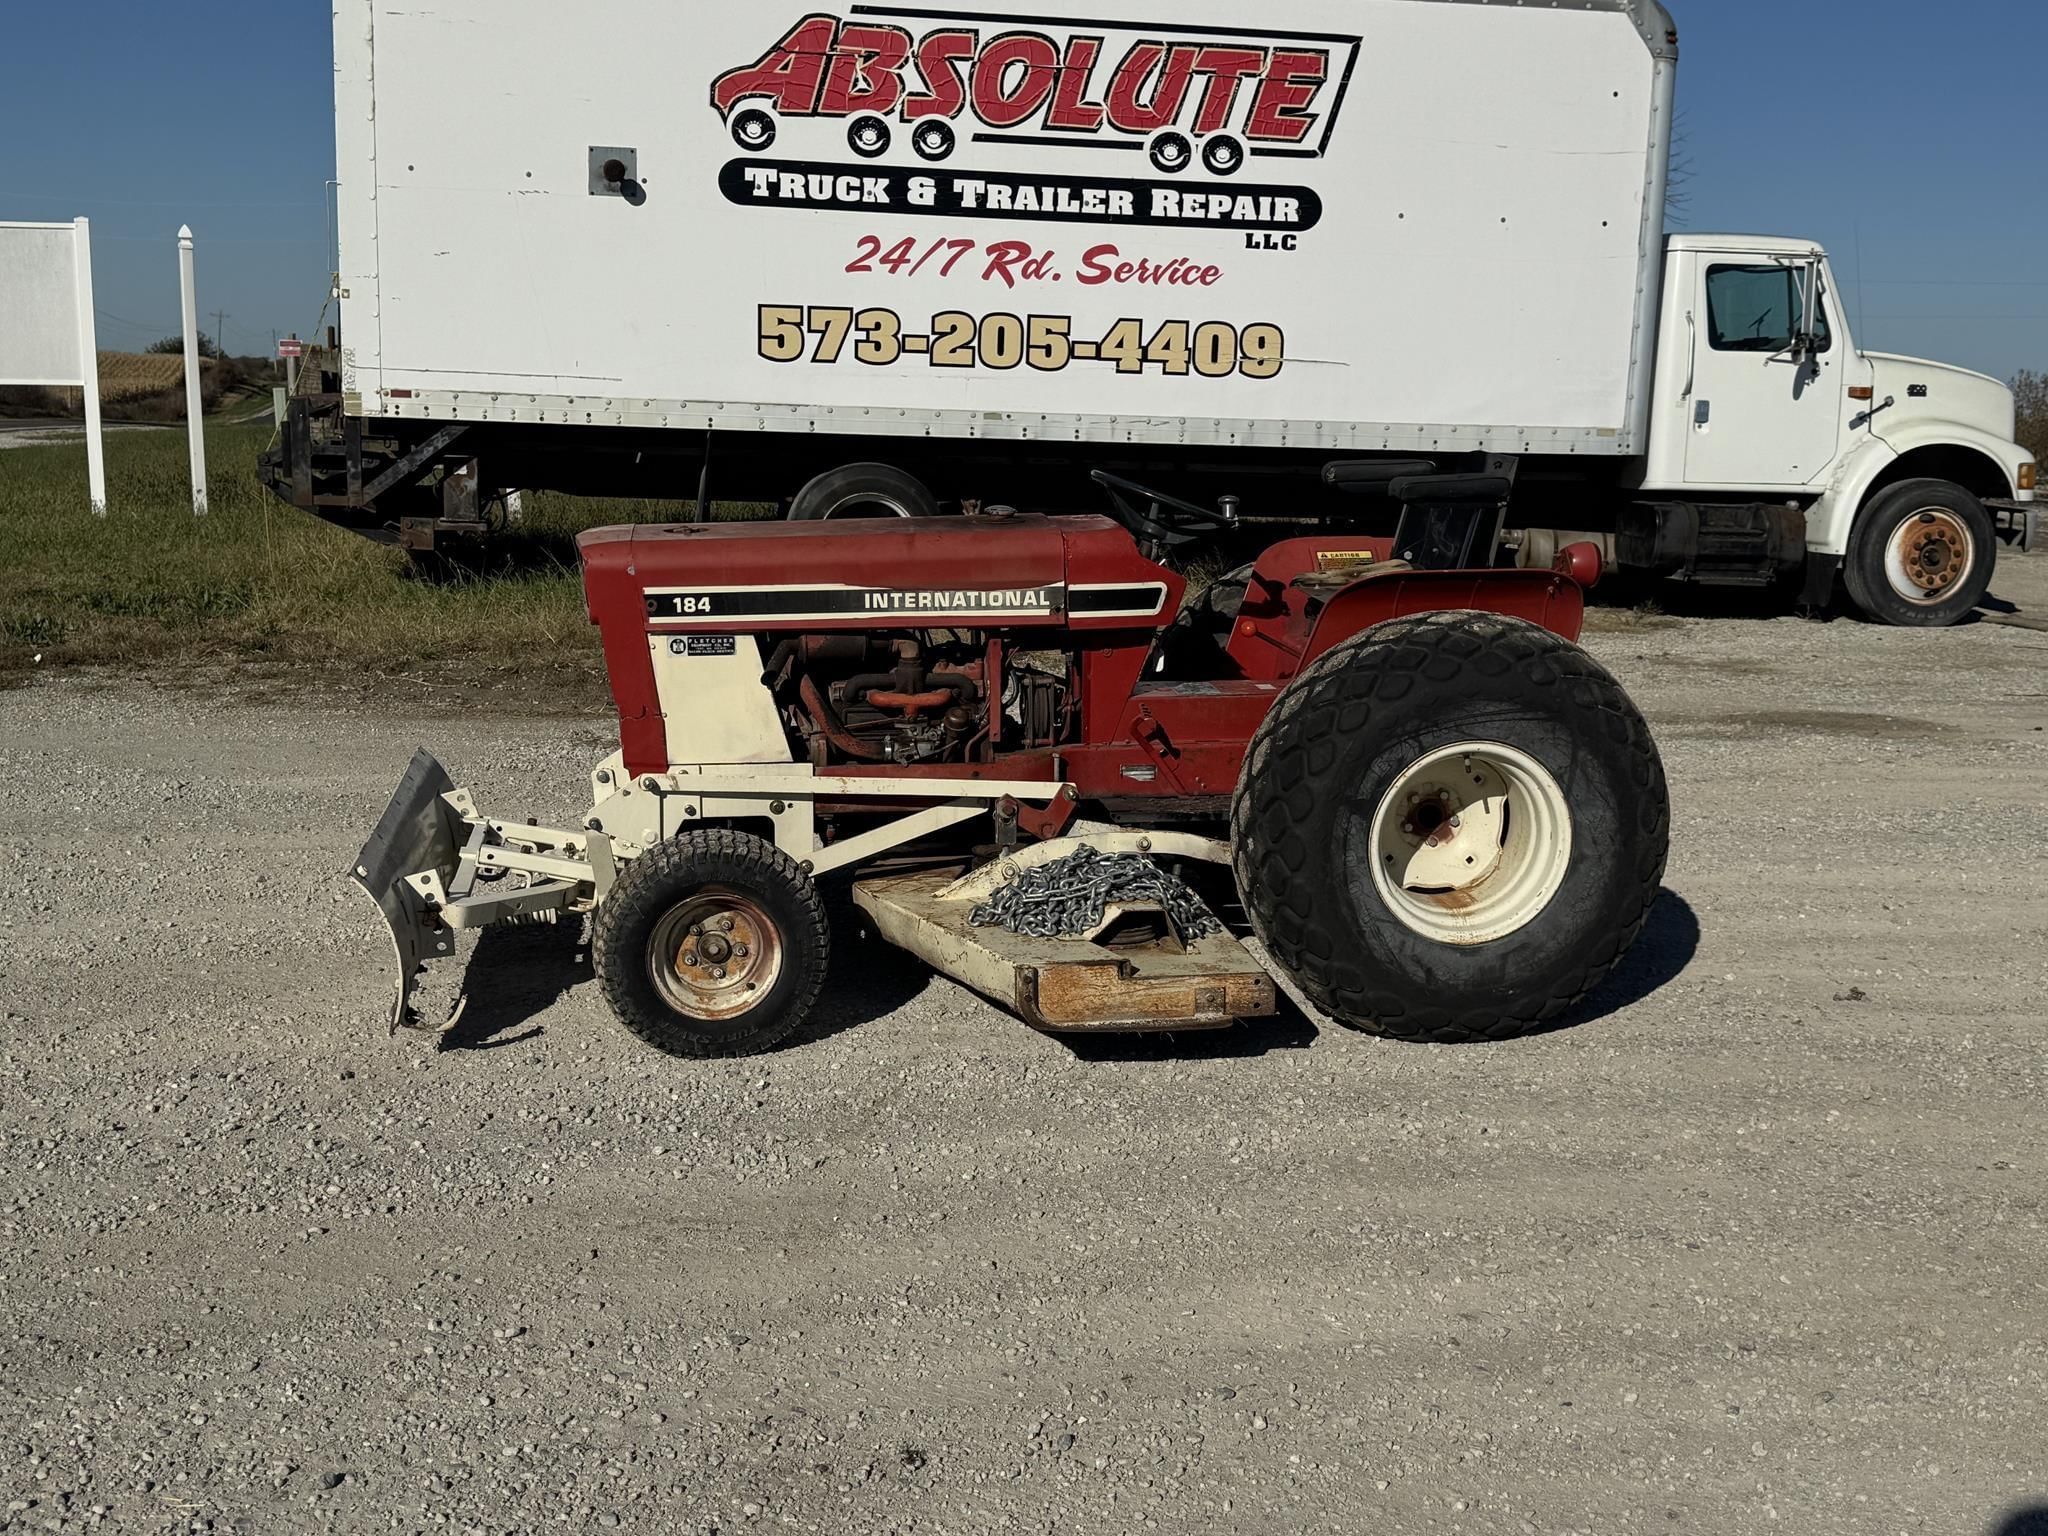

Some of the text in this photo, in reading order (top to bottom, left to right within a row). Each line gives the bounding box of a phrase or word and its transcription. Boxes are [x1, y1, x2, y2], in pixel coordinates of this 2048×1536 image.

[710, 13, 1330, 142] ABSOLUTE
[744, 167, 1299, 222] TRUCK & TRAILER REPAIR
[845, 235, 1224, 289] 24/7 Rd. Service
[1245, 233, 1298, 251] LLC
[757, 304, 1284, 379] 573-205-4409
[672, 596, 711, 613] 184
[864, 590, 1050, 609] INTERNATIONAL
